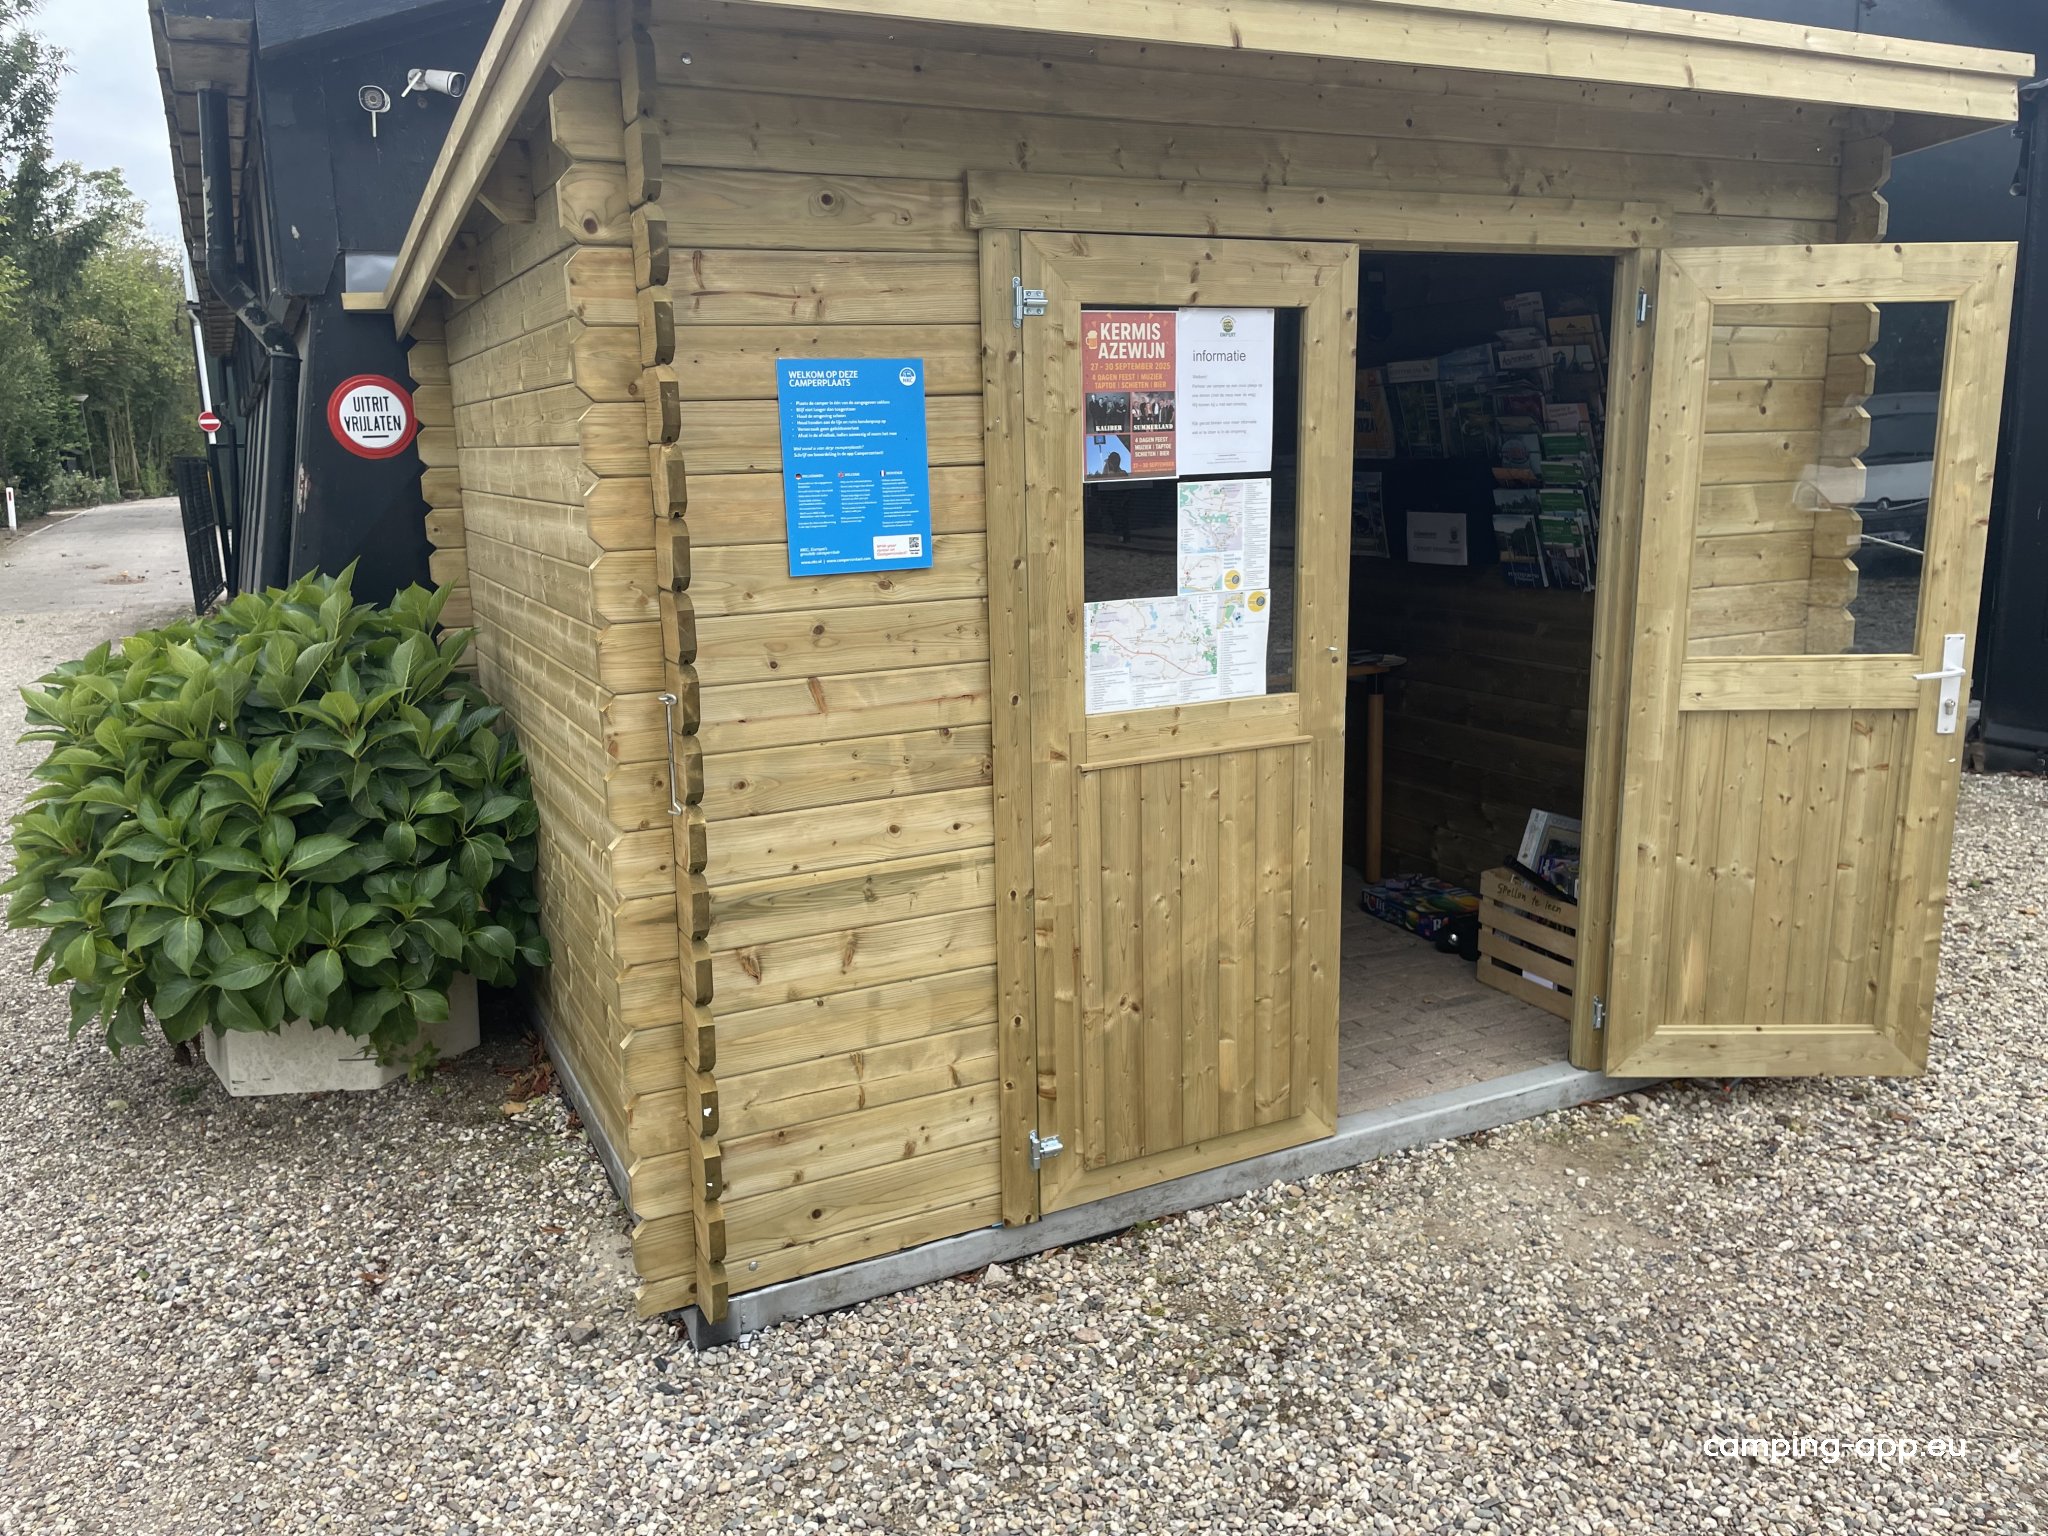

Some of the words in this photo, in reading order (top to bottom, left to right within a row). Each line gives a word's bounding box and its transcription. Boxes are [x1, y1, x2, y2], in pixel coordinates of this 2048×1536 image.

[1100, 322, 1161, 341] KERMIS
[1098, 342, 1166, 359] AZEWIJN
[1192, 350, 1247, 362] informatie
[1090, 363, 1099, 371] 27
[1104, 363, 1114, 371] 30
[1114, 362, 1154, 371] SEPTEMBER
[1155, 362, 1171, 370] 2025
[788, 370, 825, 379] WELKOM
[825, 370, 838, 379] OP
[838, 370, 859, 379] DEZE
[1097, 373, 1118, 381] DAGEN
[788, 378, 852, 388] CAMPERPLAATS
[1121, 381, 1149, 389] SCHIETEN
[352, 396, 390, 413] UITRIT
[344, 415, 402, 432] VRIJLATEN
[1095, 424, 1123, 432] KALIBER
[1133, 423, 1174, 431] SUMMERLAND
